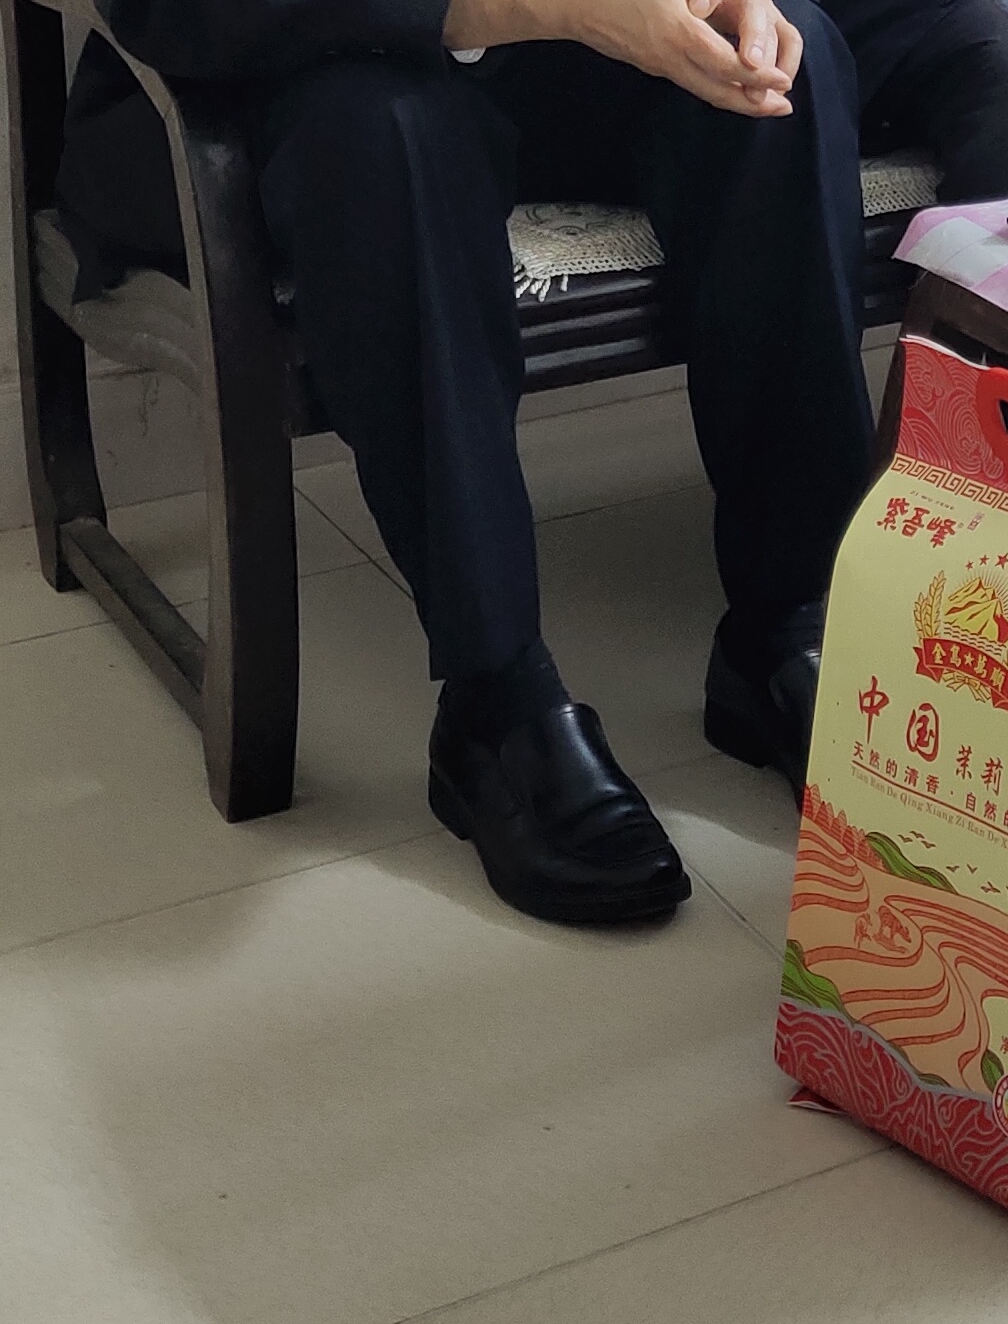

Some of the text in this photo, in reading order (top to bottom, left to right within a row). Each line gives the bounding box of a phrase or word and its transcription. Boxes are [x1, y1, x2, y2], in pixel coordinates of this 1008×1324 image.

[857, 676, 941, 763] 中国
[900, 792, 924, 812] Qing
[925, 802, 955, 824] Xiang
